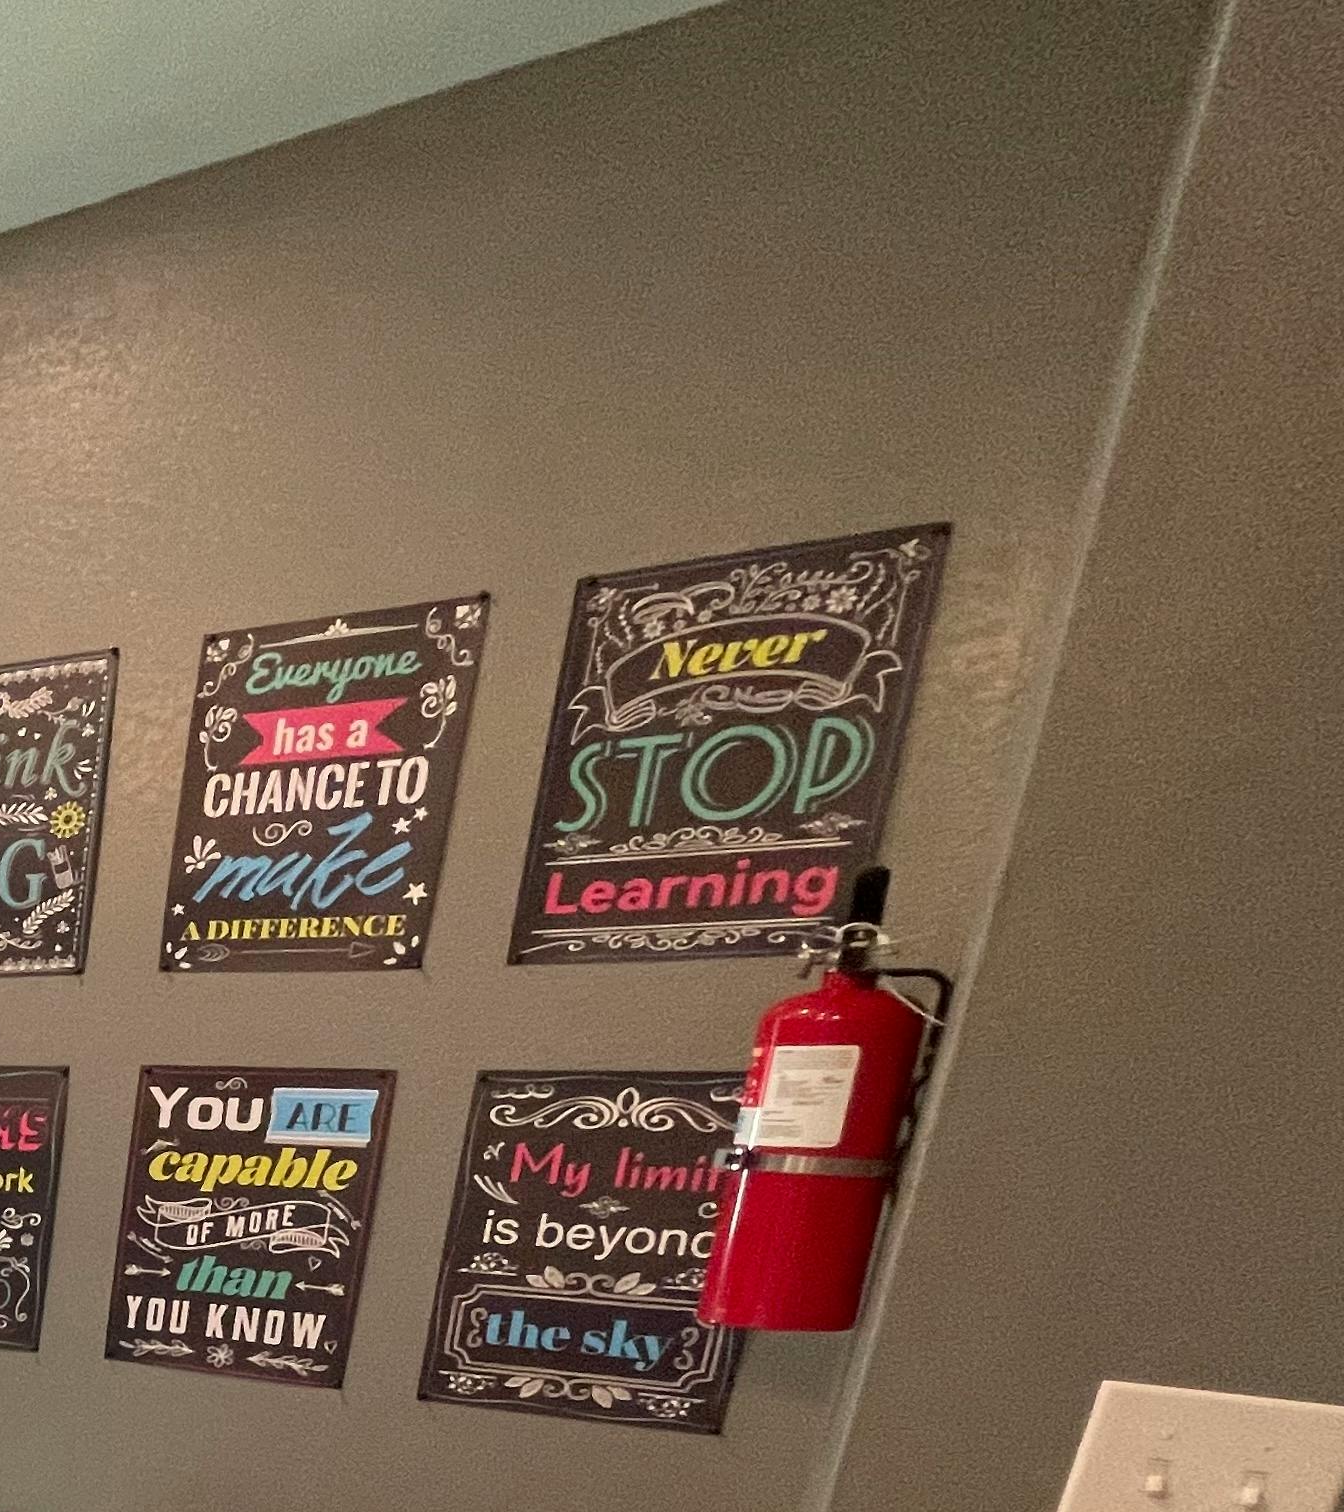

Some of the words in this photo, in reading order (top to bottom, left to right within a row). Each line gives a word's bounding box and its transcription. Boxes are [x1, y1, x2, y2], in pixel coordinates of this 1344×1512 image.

[245, 649, 423, 704] Everyone
[649, 628, 828, 682] Never
[272, 717, 335, 756] has
[346, 718, 369, 749] a
[202, 761, 367, 819] CHANCE
[375, 754, 429, 807] TO
[552, 714, 876, 833] STOP
[192, 811, 413, 911] make
[543, 858, 839, 918] Learning
[179, 920, 201, 942] A
[206, 913, 408, 941] DIFFERENCE
[148, 1085, 265, 1132] YOU
[285, 1101, 361, 1133] ARE
[148, 1147, 359, 1192] capable
[508, 1141, 593, 1198] My
[185, 1222, 214, 1246] OF
[225, 1204, 296, 1238] MORE
[481, 1209, 520, 1245] is
[175, 1254, 294, 1300] than
[125, 1295, 191, 1335] YOU
[205, 1302, 328, 1350] KNOW
[483, 1309, 572, 1352] the
[581, 1318, 670, 1373] sky
